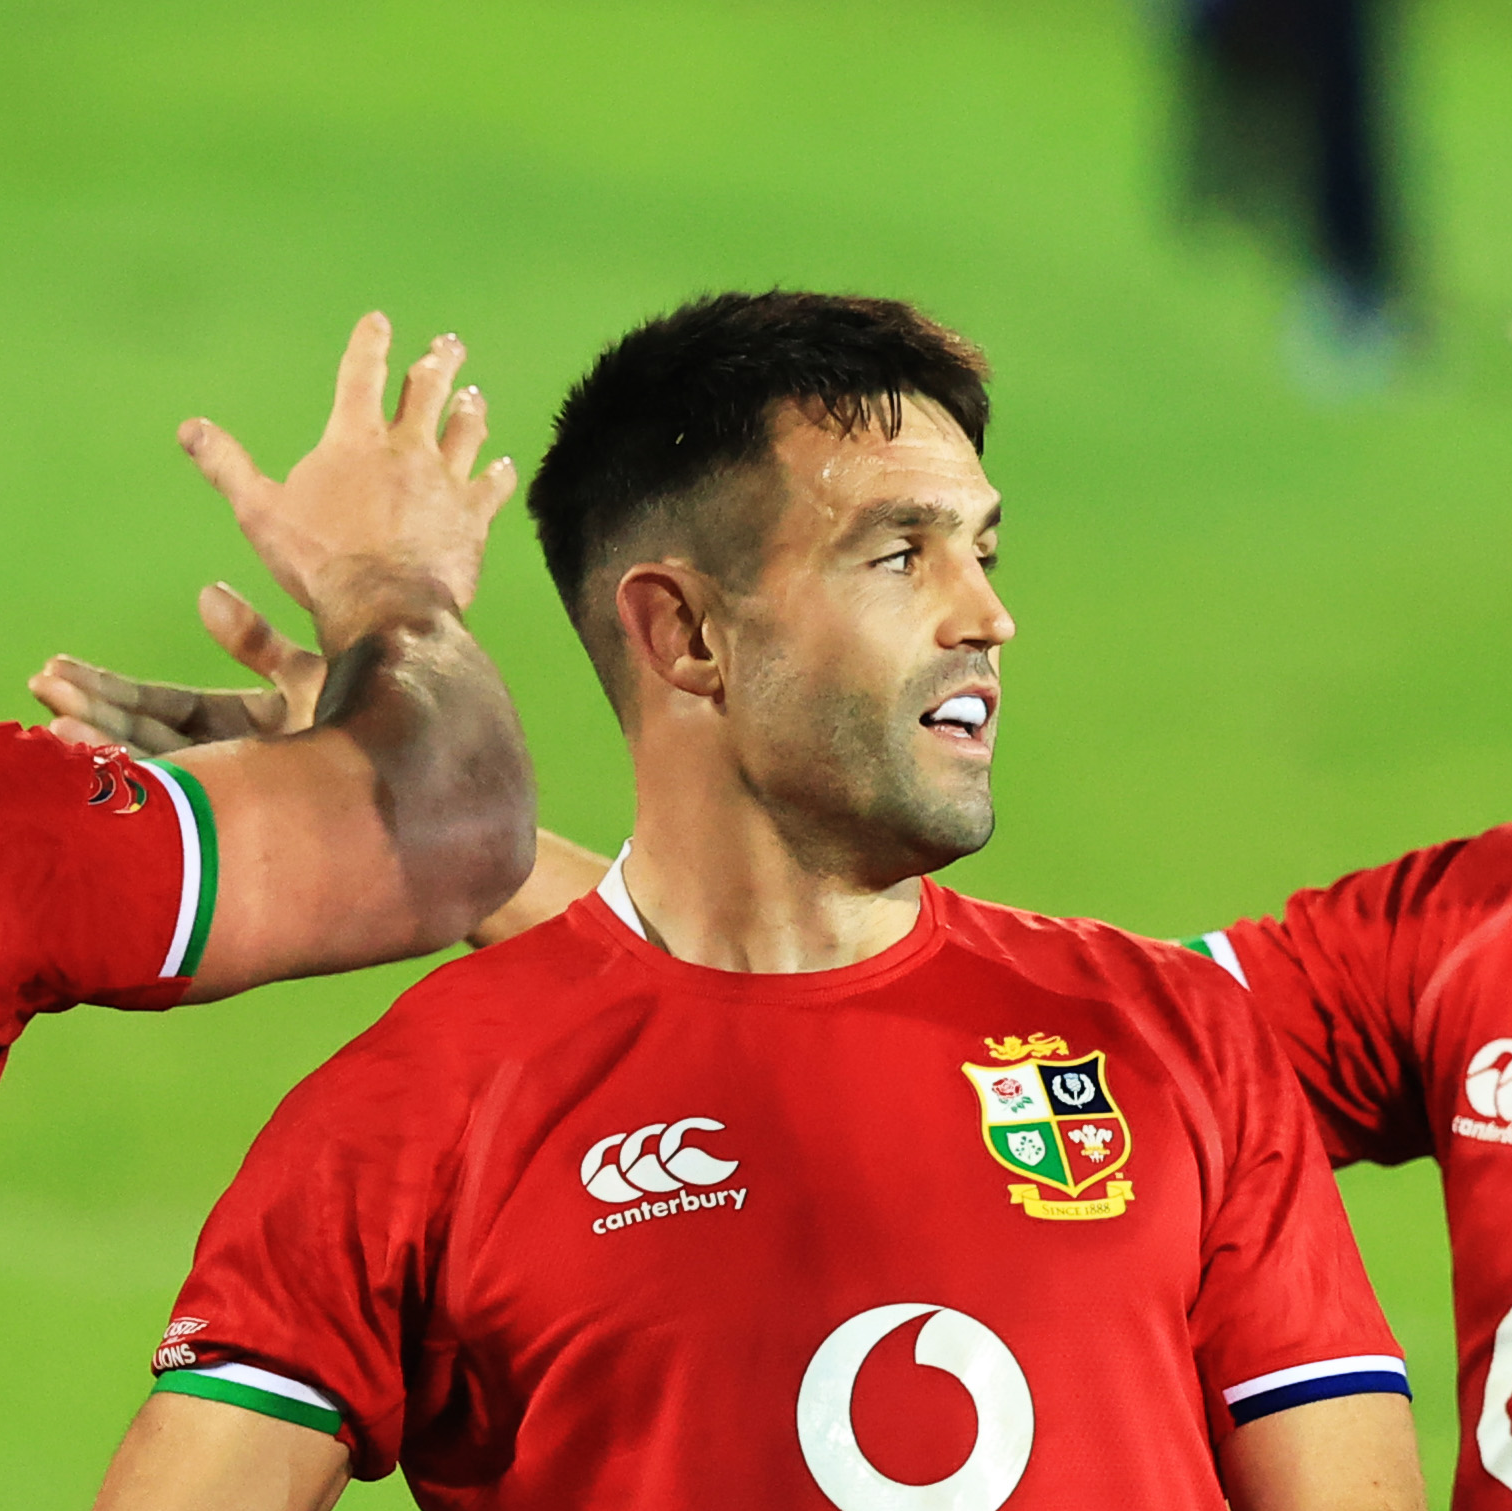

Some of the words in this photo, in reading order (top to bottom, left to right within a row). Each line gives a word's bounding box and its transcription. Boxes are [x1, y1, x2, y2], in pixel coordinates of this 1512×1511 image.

[592, 1187, 747, 1235] canterbury
[1042, 1204, 1082, 1217] SINCE
[1084, 1203, 1111, 1215] 1888
[152, 1343, 197, 1370] LIONS
